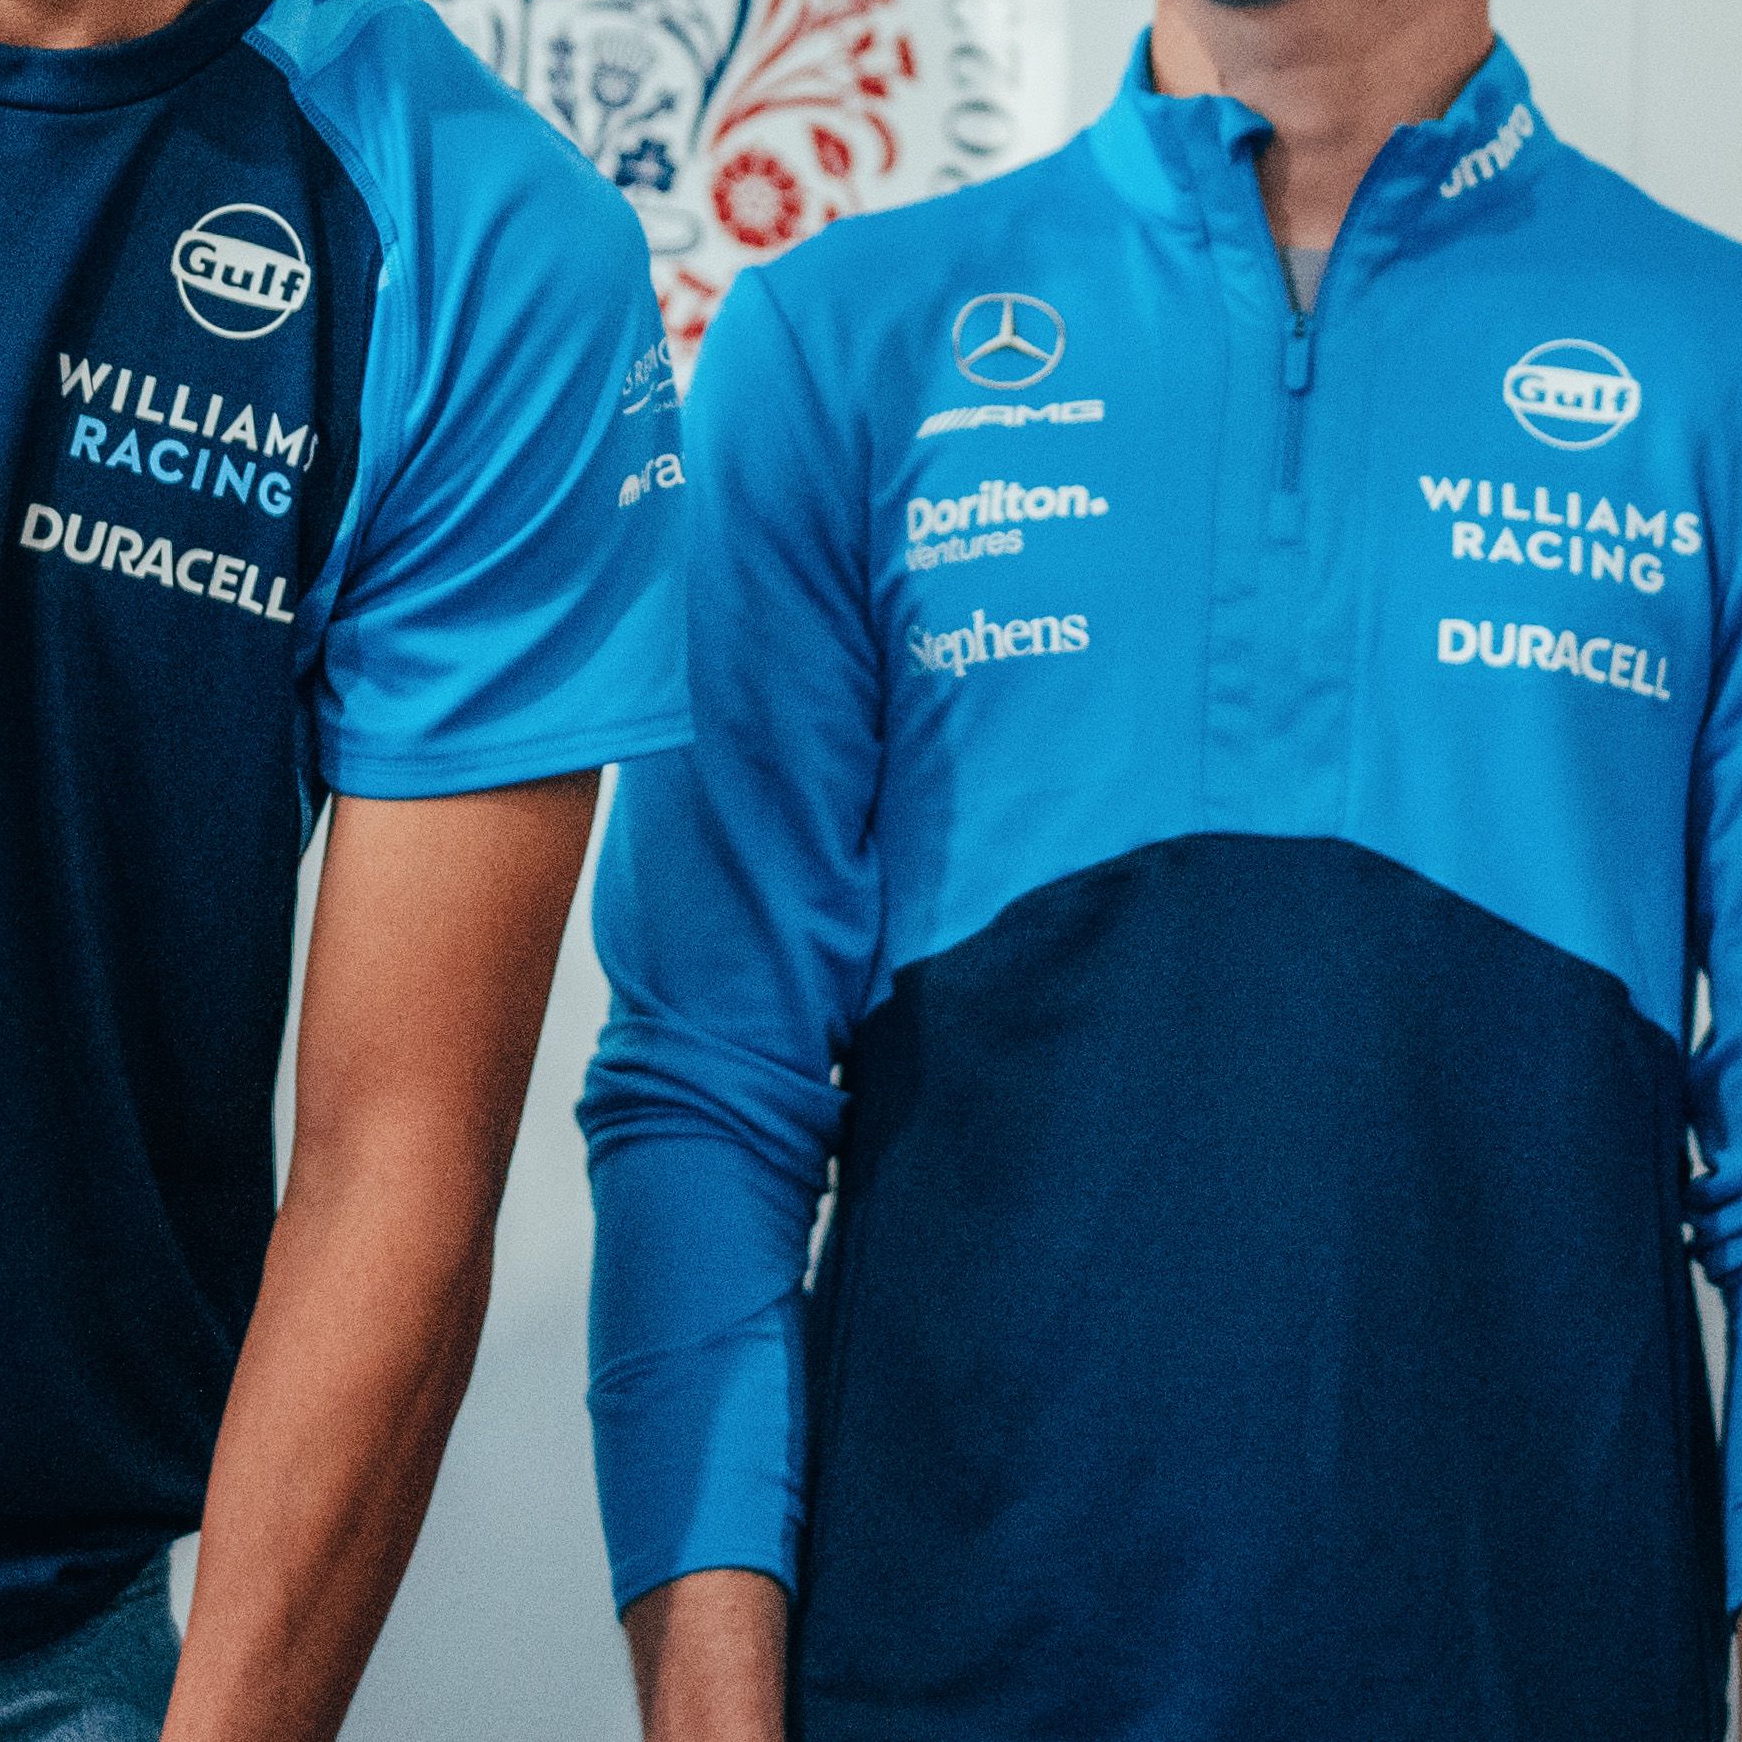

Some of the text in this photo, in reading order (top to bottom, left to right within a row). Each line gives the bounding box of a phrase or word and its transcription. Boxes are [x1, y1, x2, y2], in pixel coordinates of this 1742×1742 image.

[178, 239, 303, 302] Gulf
[59, 353, 319, 472] WILLIAM
[973, 400, 1105, 427] AMG
[1511, 371, 1632, 416] Gulf
[70, 414, 293, 516] RACING
[906, 529, 1024, 571] Ventures
[1419, 475, 1702, 556] WILLIAMS
[20, 503, 295, 623] DURACELL
[1452, 521, 1665, 594] RACING
[1438, 618, 1670, 700] DURACELL
